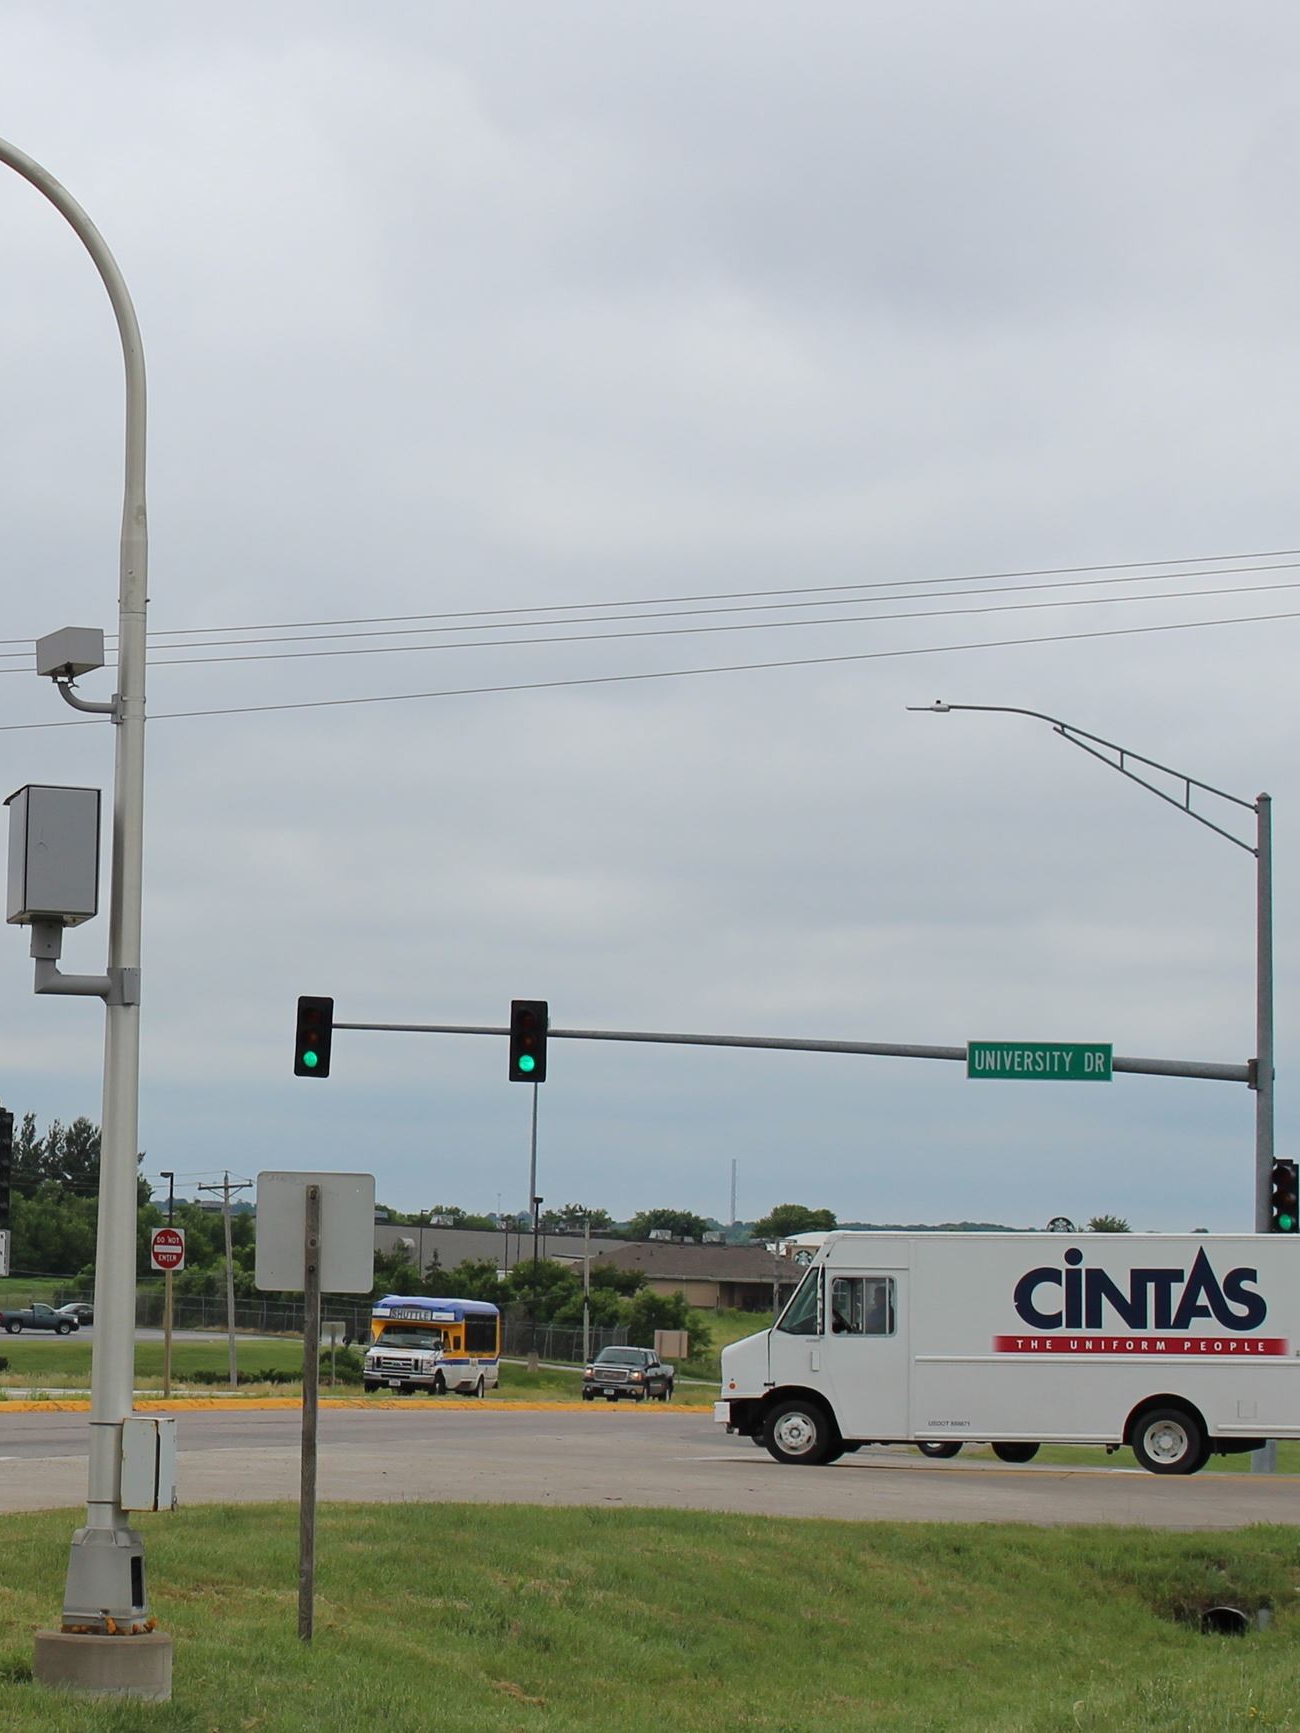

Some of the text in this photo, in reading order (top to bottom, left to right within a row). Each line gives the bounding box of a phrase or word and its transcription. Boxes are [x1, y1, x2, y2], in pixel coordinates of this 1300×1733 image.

[975, 1049, 1105, 1072] UNIVERSITY DR
[167, 1235, 180, 1244] NOT
[159, 1254, 177, 1262] ENTER
[391, 1308, 430, 1320] SHUTTLE
[1016, 1339, 1265, 1352] THE UNIFORM PEOPLE
